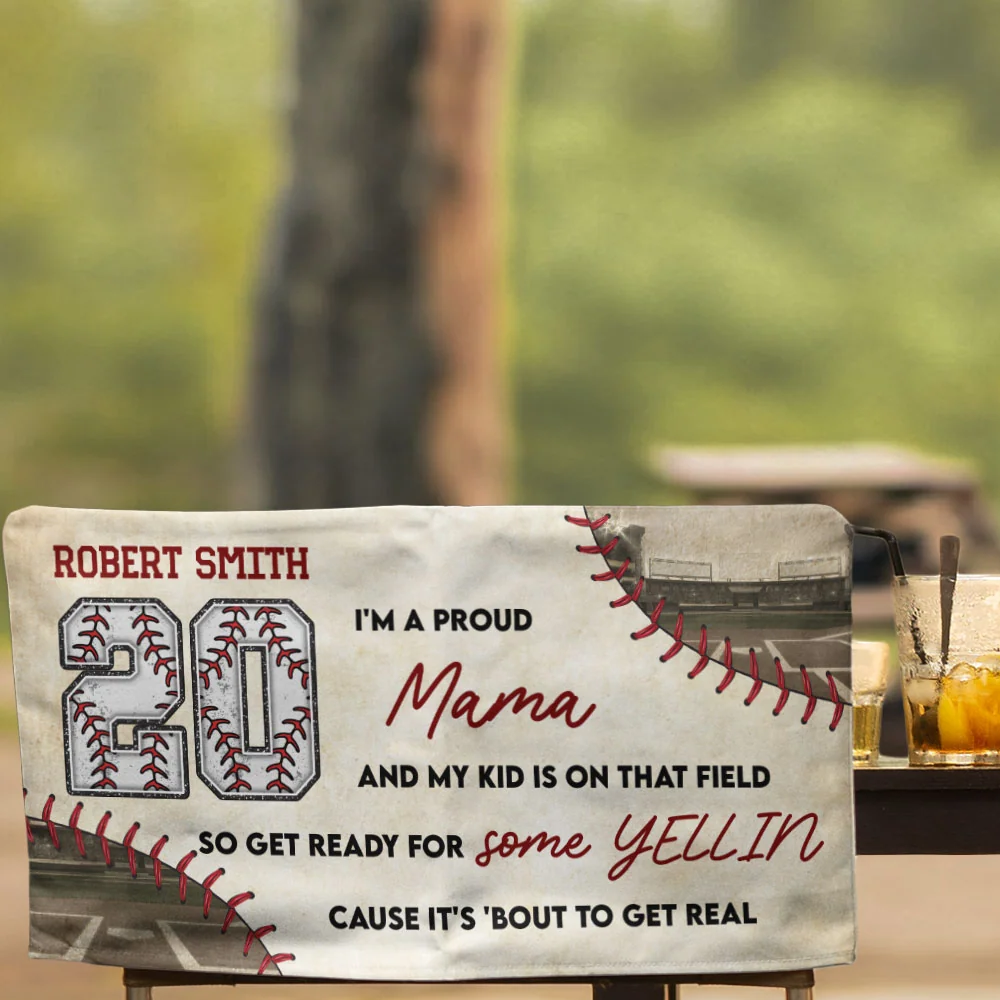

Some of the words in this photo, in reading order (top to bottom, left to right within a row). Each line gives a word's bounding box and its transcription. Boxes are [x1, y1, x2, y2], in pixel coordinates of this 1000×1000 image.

[52, 544, 183, 579] ROBERT
[195, 546, 310, 580] SMITH
[355, 608, 395, 632] I'M
[403, 608, 425, 632] A
[433, 607, 533, 633] PROUD
[57, 596, 322, 802] 20
[385, 661, 597, 740] Mama
[357, 763, 419, 789] AND
[427, 764, 470, 789] MY
[478, 764, 525, 789] KID
[533, 764, 558, 789] IS
[565, 764, 609, 789] ON
[616, 764, 689, 789] THAT
[696, 764, 771, 789] FIELD
[198, 830, 238, 856] SO
[245, 831, 300, 857] GET
[308, 833, 400, 858] READY
[408, 834, 465, 859] FOR
[474, 830, 592, 868] some
[607, 811, 825, 882] YELLIN
[328, 905, 420, 931] CAUSE
[428, 905, 476, 931] IT'S
[483, 905, 568, 930] 'BOUT
[574, 903, 614, 928] TO
[622, 903, 678, 928] GET
[685, 901, 758, 926] REAL
